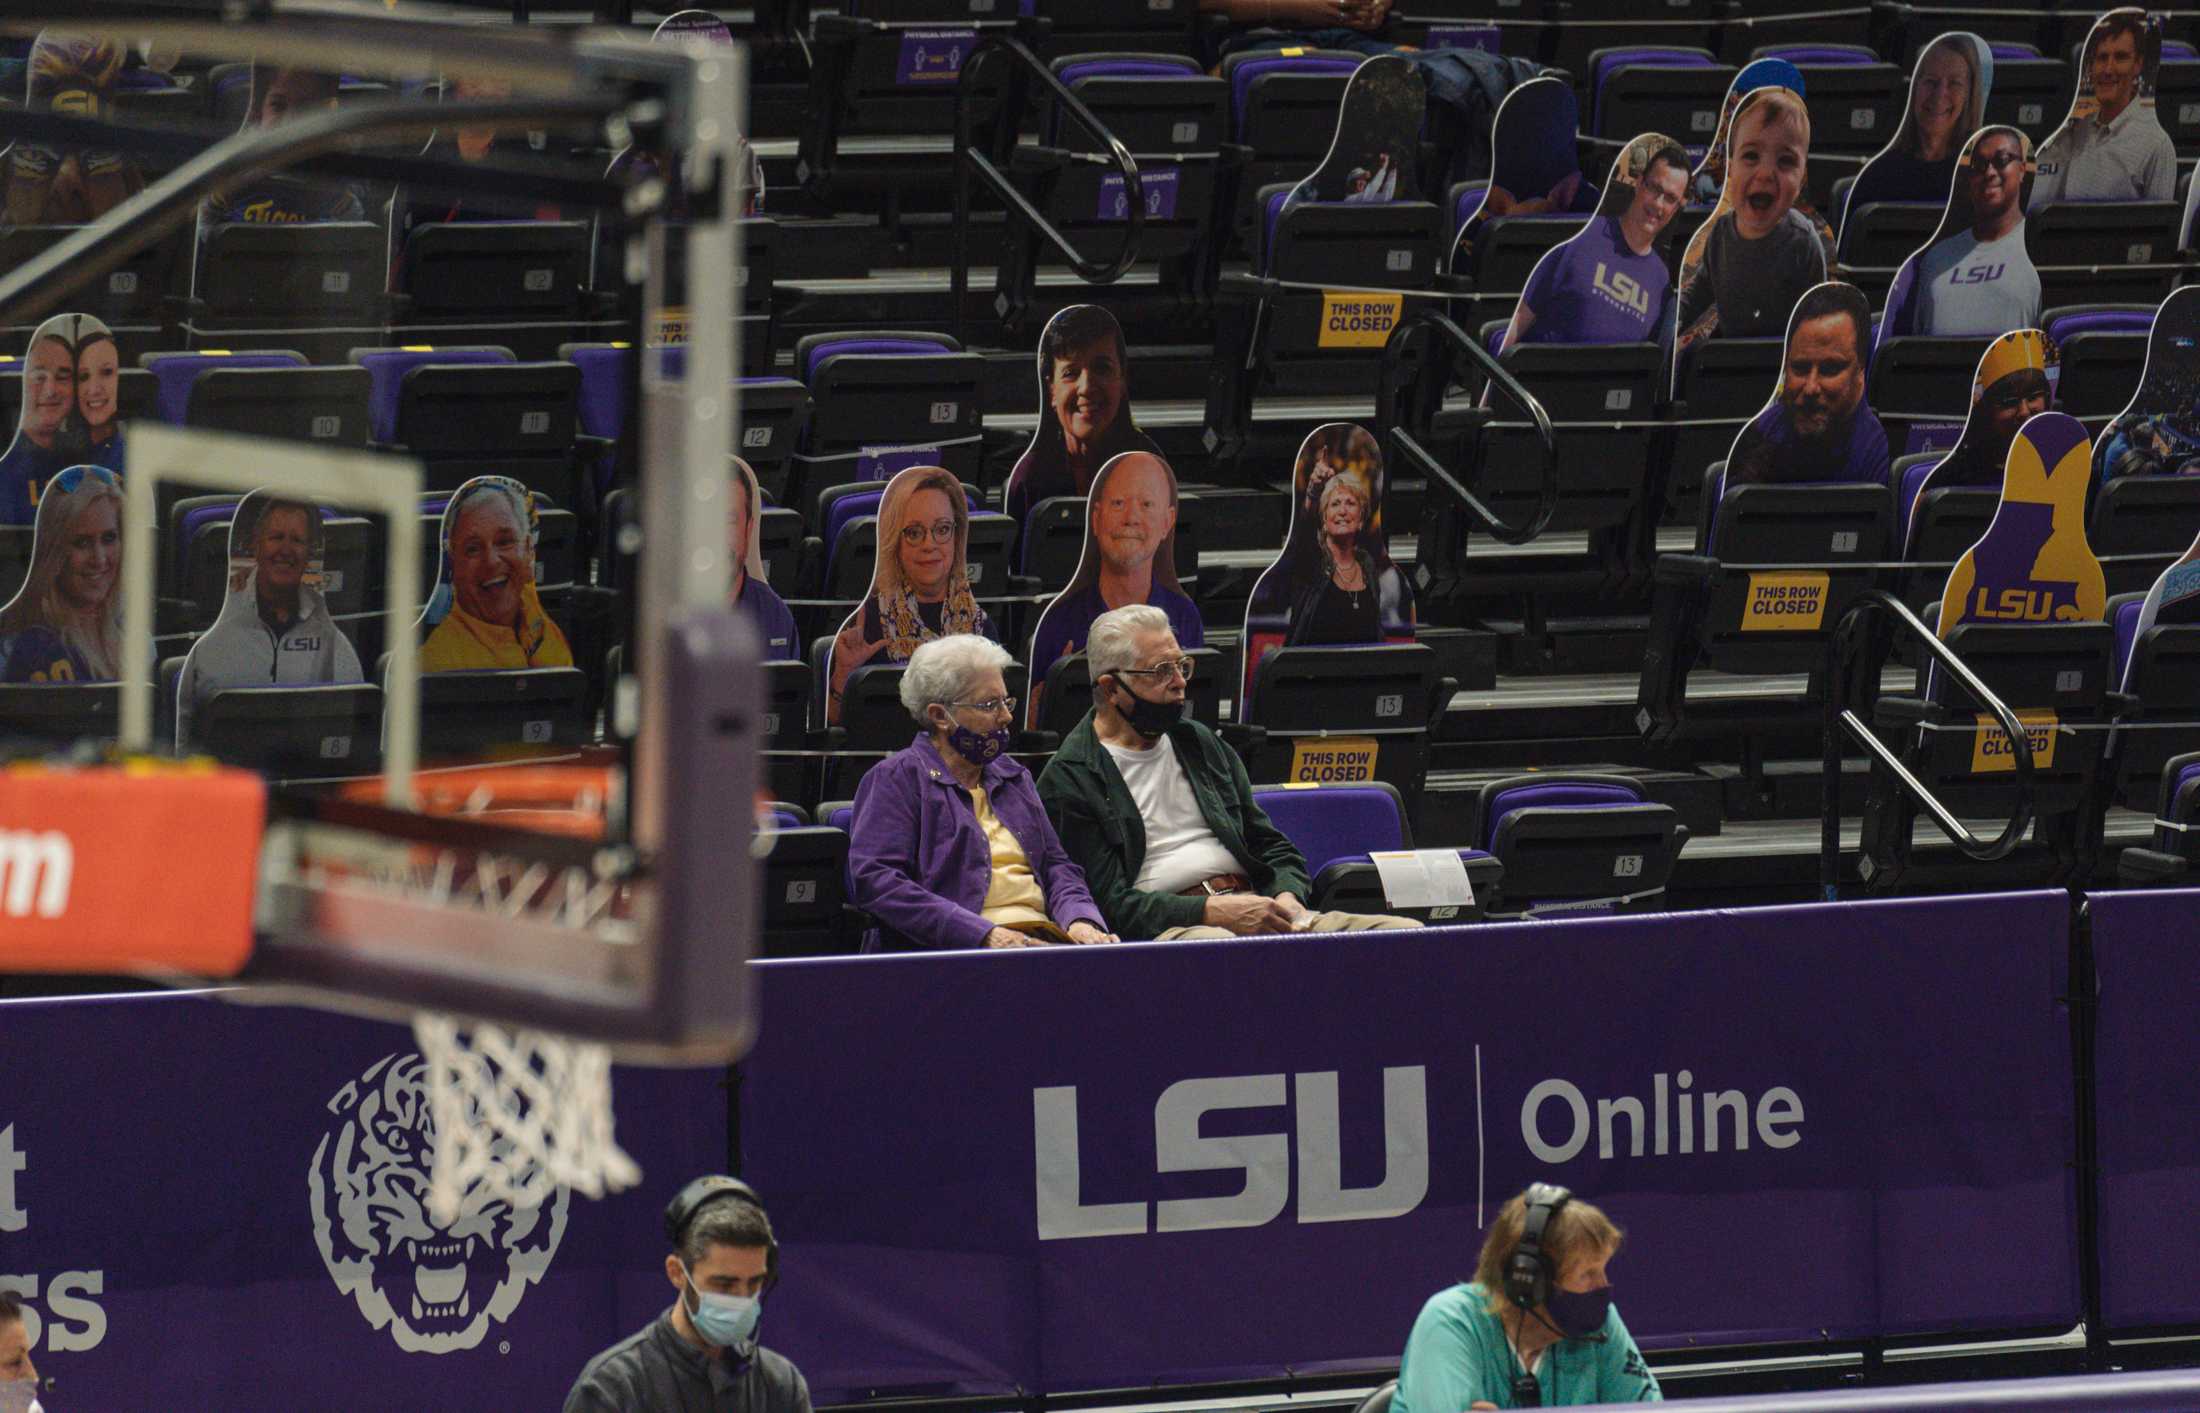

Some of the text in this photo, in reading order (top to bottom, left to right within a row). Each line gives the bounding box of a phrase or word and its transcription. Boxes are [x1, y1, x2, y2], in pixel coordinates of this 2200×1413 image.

[2037, 161, 2059, 175] SU
[1950, 263, 2007, 284] LSU
[1593, 262, 1649, 315] LSU
[1330, 304, 1395, 316] THIS ROW
[1329, 316, 1393, 331] CLOSED
[750, 429, 766, 445] 12
[1756, 586, 1821, 598] THIS ROW
[1752, 600, 1818, 615] CLOSED
[1975, 587, 2053, 621] LSU
[284, 638, 320, 652] LSU
[1982, 737, 2050, 755] CLOED
[1302, 752, 1370, 765] THIS ROW
[1299, 766, 1368, 782] CLOSED
[1033, 1064, 1805, 1241] LSU Online
